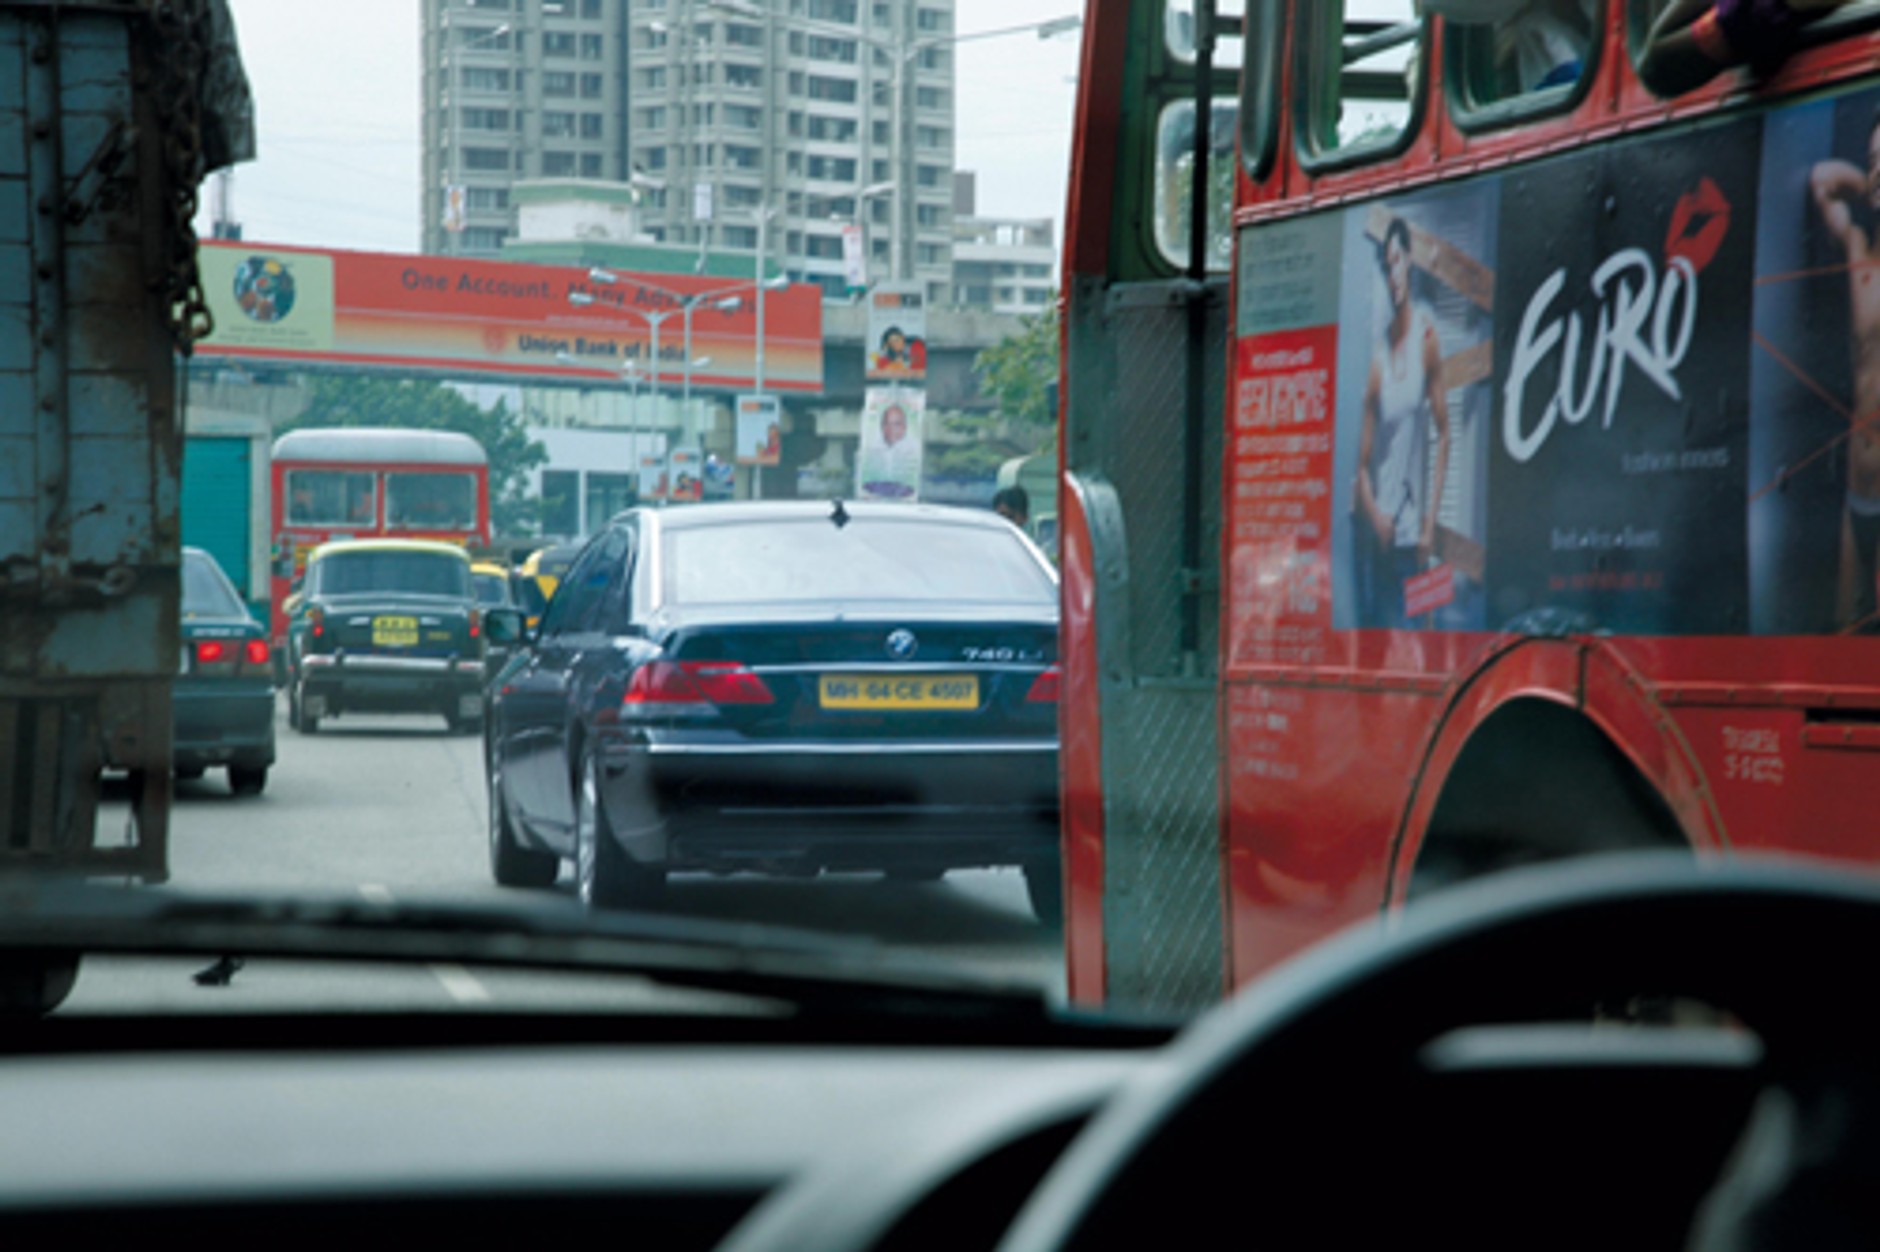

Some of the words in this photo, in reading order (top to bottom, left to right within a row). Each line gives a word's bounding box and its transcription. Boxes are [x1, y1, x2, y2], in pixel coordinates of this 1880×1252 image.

[402, 268, 447, 292] One
[457, 273, 558, 301] Account.
[519, 334, 569, 353] Union
[575, 337, 617, 355] Bank
[624, 340, 640, 357] of
[1503, 246, 1699, 464] EURO
